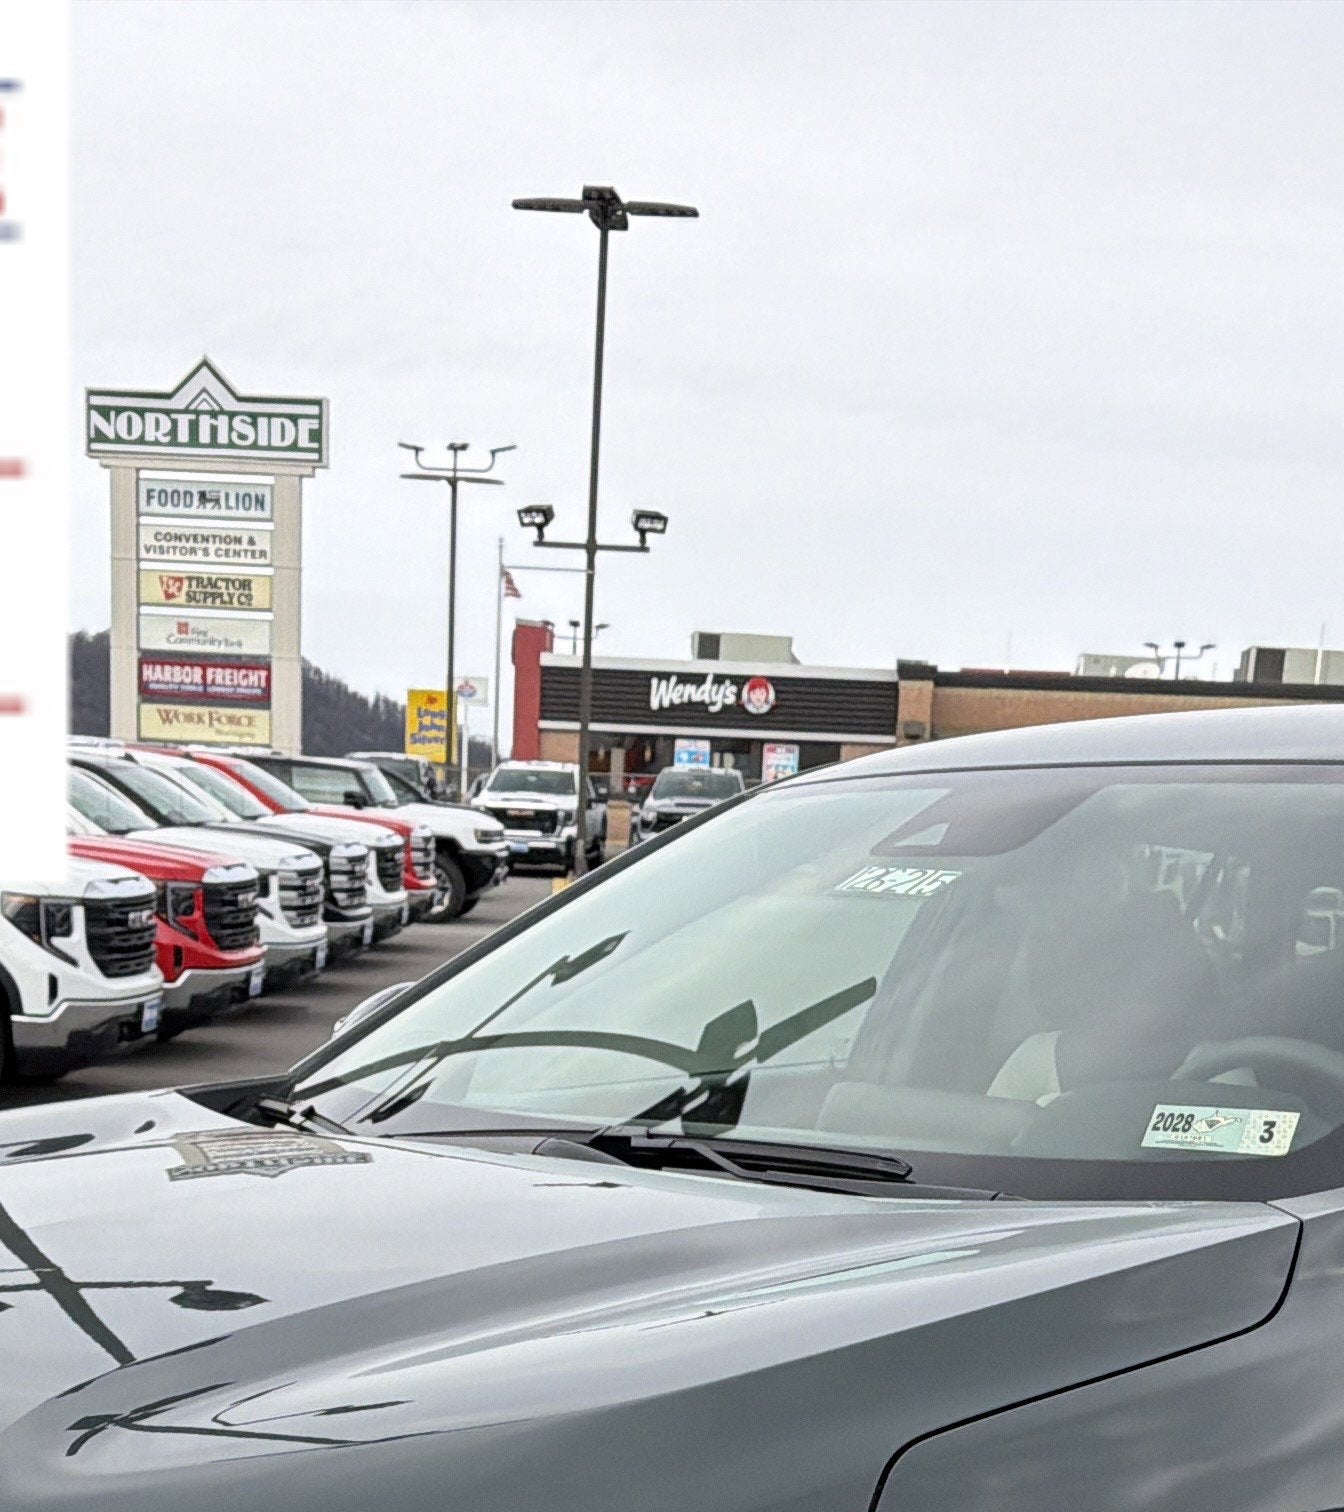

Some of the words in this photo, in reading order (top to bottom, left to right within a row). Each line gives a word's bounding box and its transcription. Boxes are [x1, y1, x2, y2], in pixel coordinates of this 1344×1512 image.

[89, 408, 320, 449] NORTHSIDE
[146, 488, 194, 509] FOOD
[224, 491, 266, 512] LION
[153, 531, 244, 546] CONVENTION
[247, 535, 257, 547] &
[143, 544, 211, 558] VISITOR'S
[213, 546, 268, 560] CENTER
[185, 575, 253, 592] TRACTOR
[184, 590, 235, 606] SUPPLY
[142, 664, 203, 684] HARBOR
[205, 667, 269, 688] FREIGHT
[650, 673, 738, 712] Wendy's
[1151, 1112, 1196, 1134] 2028
[1258, 1120, 1277, 1144] 3
